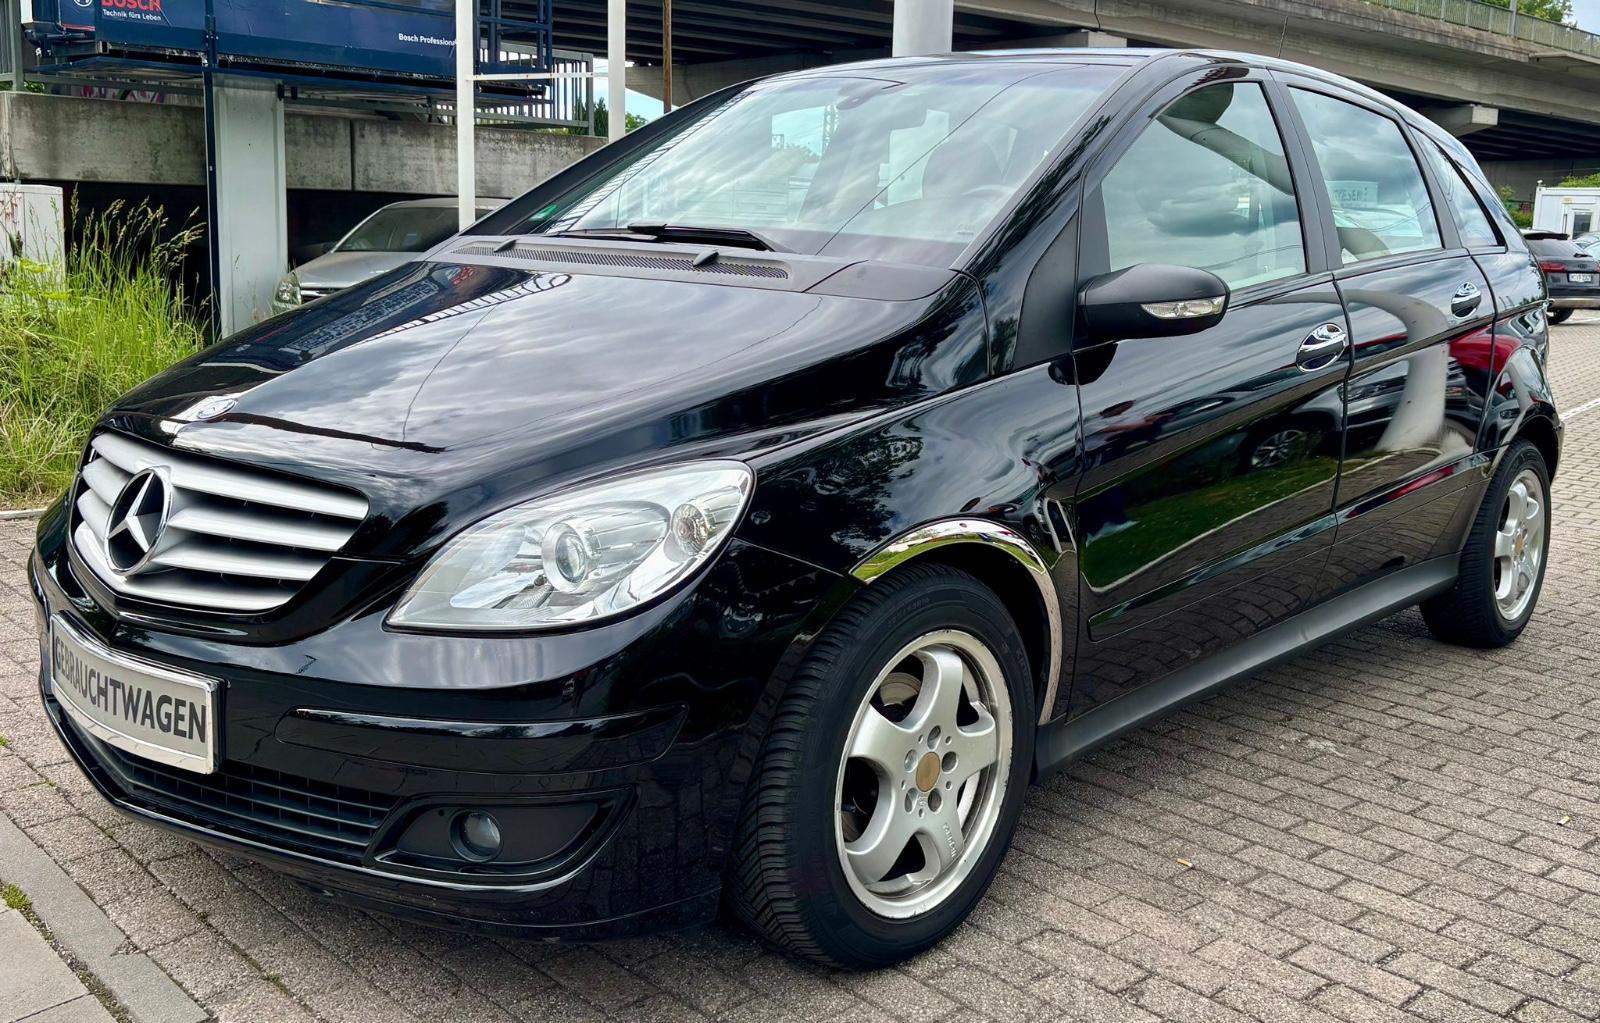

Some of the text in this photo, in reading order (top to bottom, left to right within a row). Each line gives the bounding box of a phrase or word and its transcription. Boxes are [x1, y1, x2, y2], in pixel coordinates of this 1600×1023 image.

[102, 8, 162, 21] Technik fürs Leben
[398, 33, 419, 43] Bosch
[55, 636, 207, 743] GEBRAUCHTWAGEN
